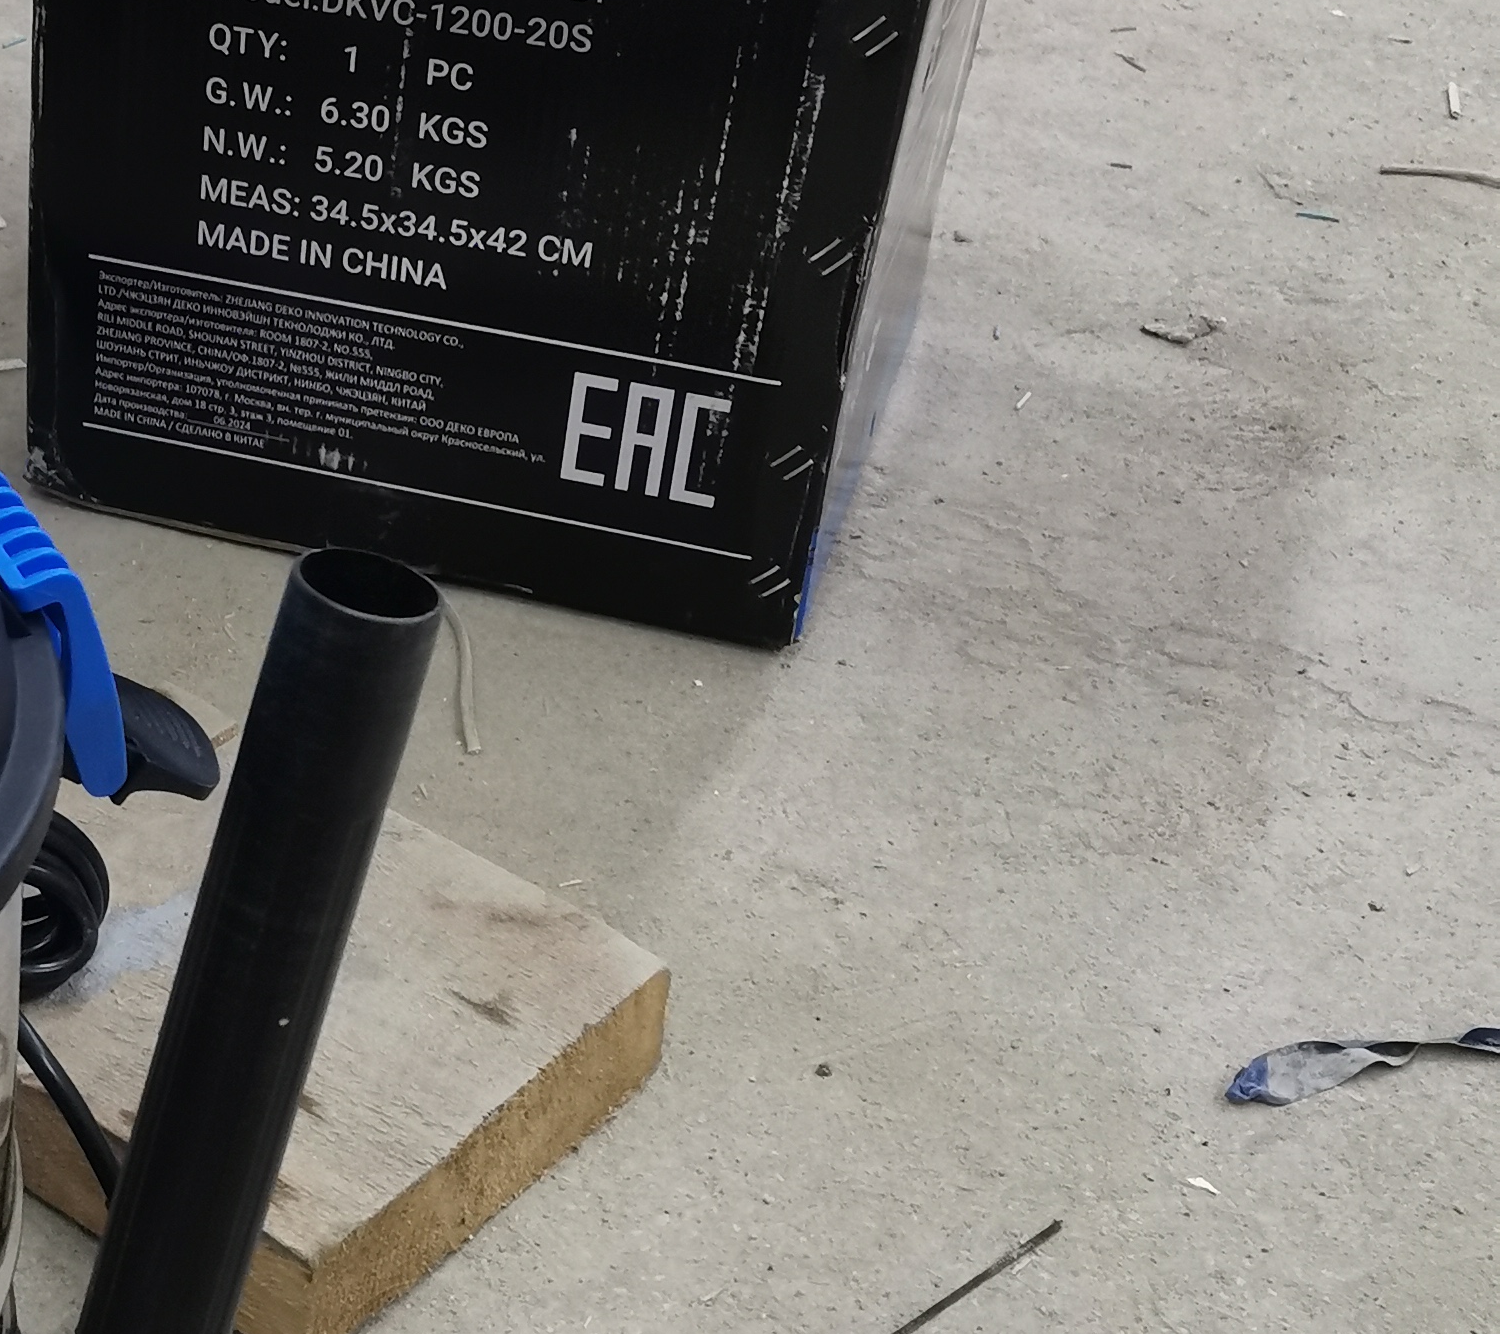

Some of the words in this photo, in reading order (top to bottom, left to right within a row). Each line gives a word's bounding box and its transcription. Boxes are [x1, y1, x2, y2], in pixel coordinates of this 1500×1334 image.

[208, 22, 288, 62] QTY:
[343, 44, 358, 74] 1
[425, 57, 475, 92] PC
[319, 96, 391, 134] 6.30
[417, 111, 490, 150] KGS
[202, 124, 288, 166] N.W.:
[313, 144, 384, 183] 5.20
[410, 161, 482, 200] KGS
[196, 219, 292, 263] MADE
[298, 238, 334, 270] IN
[341, 246, 448, 292] CHINA
[199, 173, 301, 219] MEAS:
[308, 194, 529, 258] 34.5x34.5x42
[536, 233, 595, 270] CM
[558, 370, 734, 510] EAC
